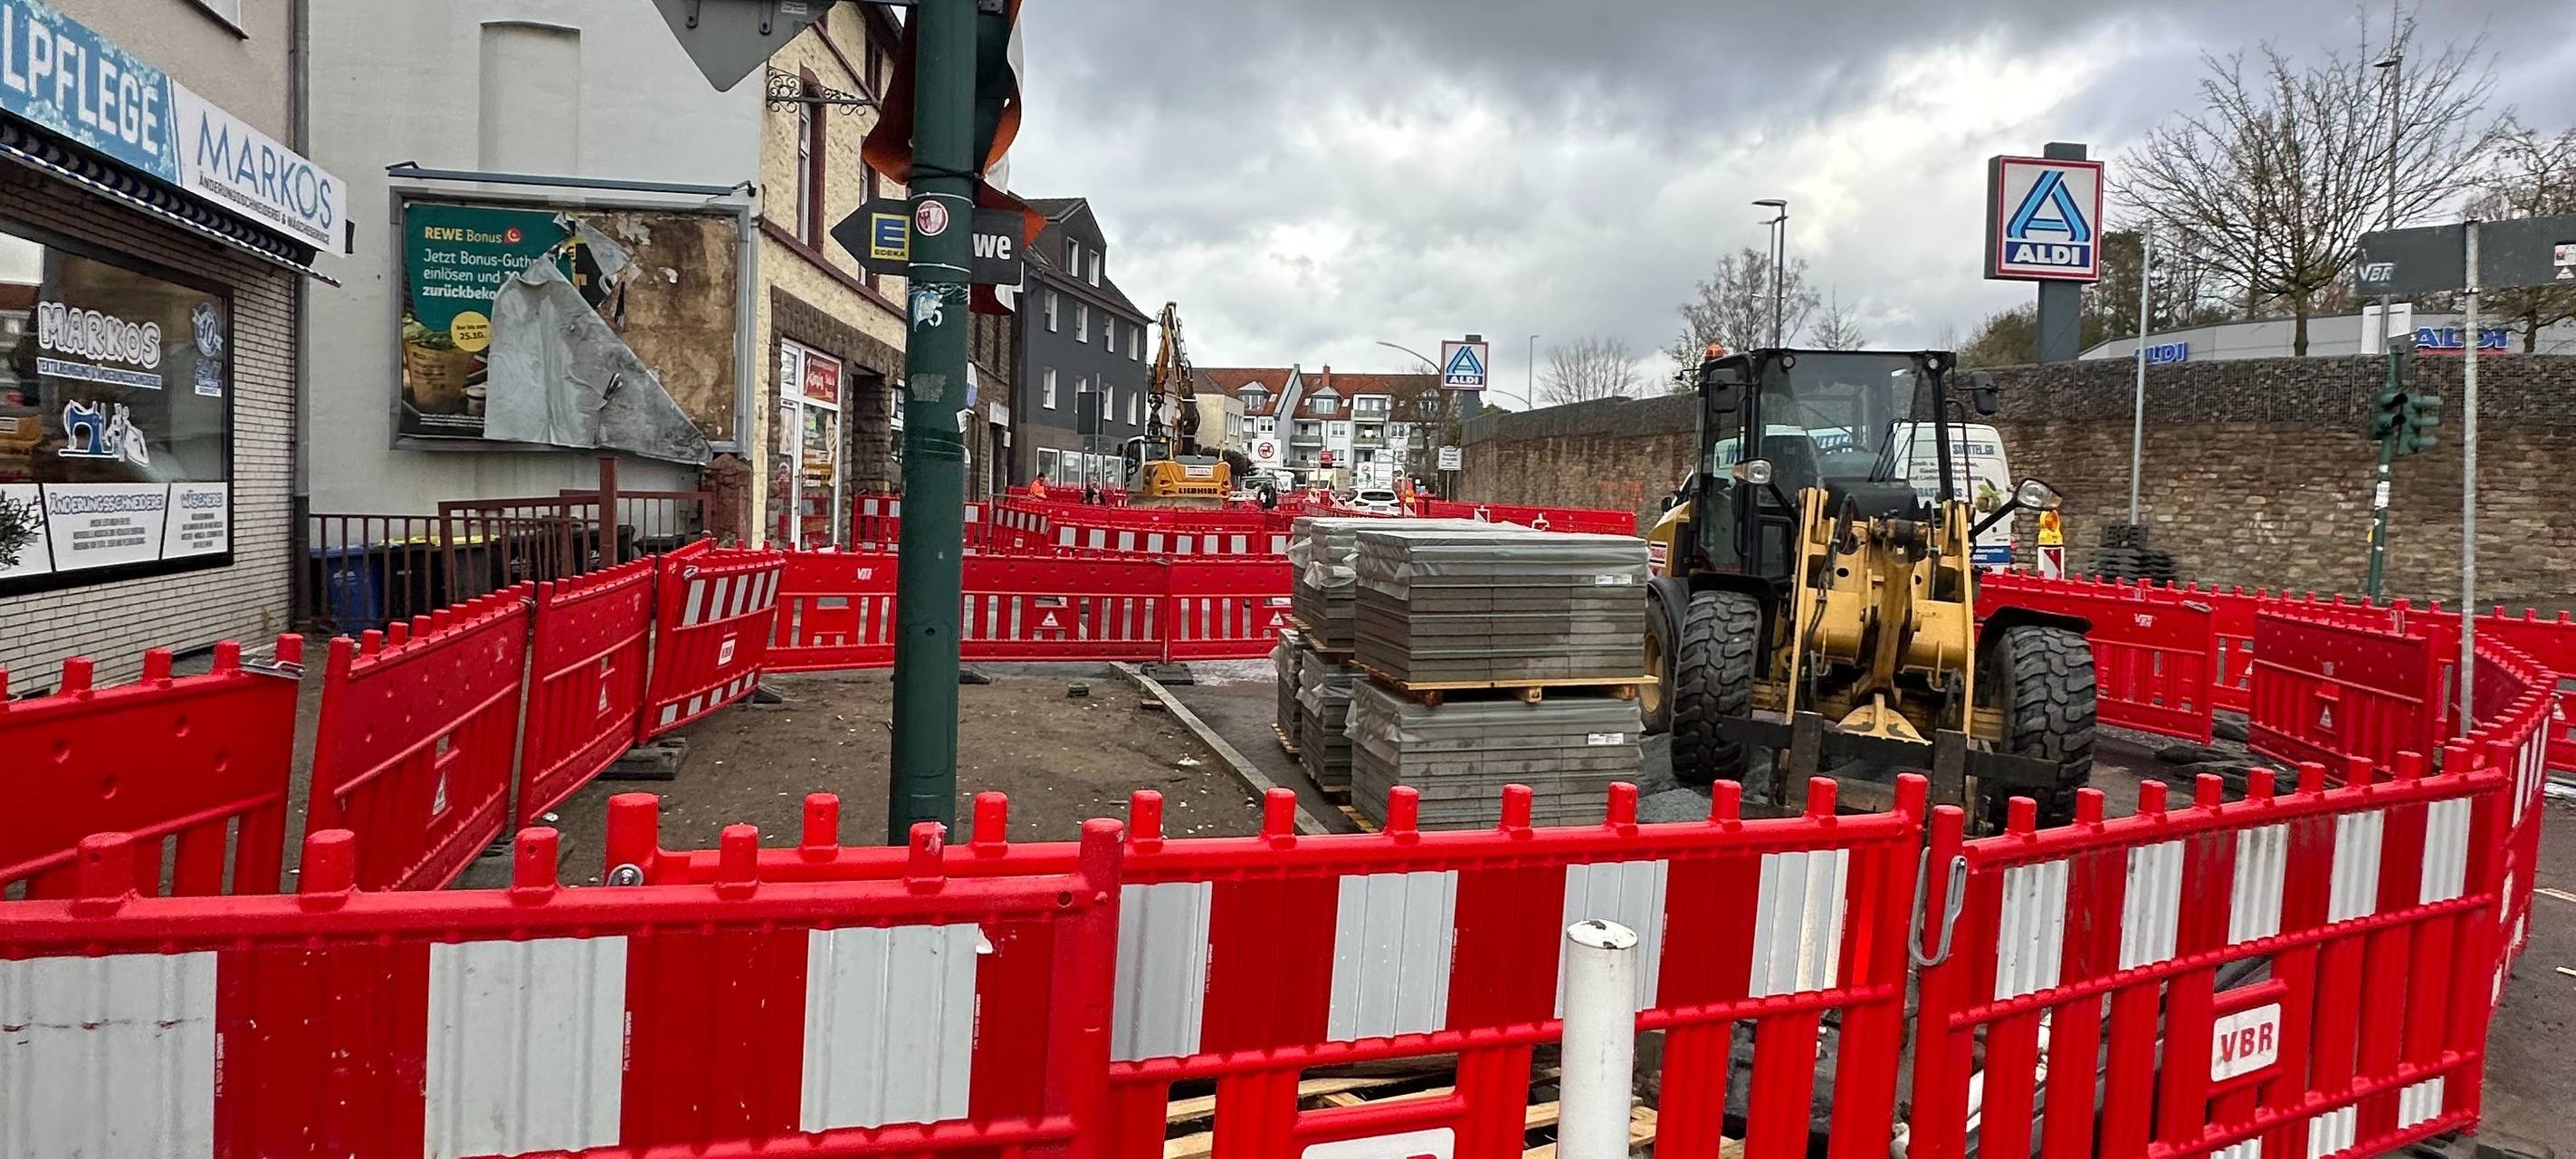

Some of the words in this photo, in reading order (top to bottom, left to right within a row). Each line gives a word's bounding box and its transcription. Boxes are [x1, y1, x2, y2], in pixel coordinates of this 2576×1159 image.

[3, 4, 158, 157] LPFLEGE
[197, 109, 331, 229] MARKOS
[425, 226, 463, 242] REWE
[466, 230, 502, 244] Bonus
[423, 248, 456, 263] Jetzt
[460, 252, 539, 269] Bonus-Guth
[874, 249, 906, 257] EDEKA
[2013, 244, 2081, 265] ALDI
[424, 266, 474, 282] einlösen
[477, 268, 501, 283] und
[2359, 262, 2395, 283] VBR
[38, 301, 161, 369] MARKOS
[1448, 376, 1479, 385] ALDI
[50, 492, 164, 515] ÄNDERUNGSSCHNEIDEREI
[2221, 1022, 2273, 1063] VBR
